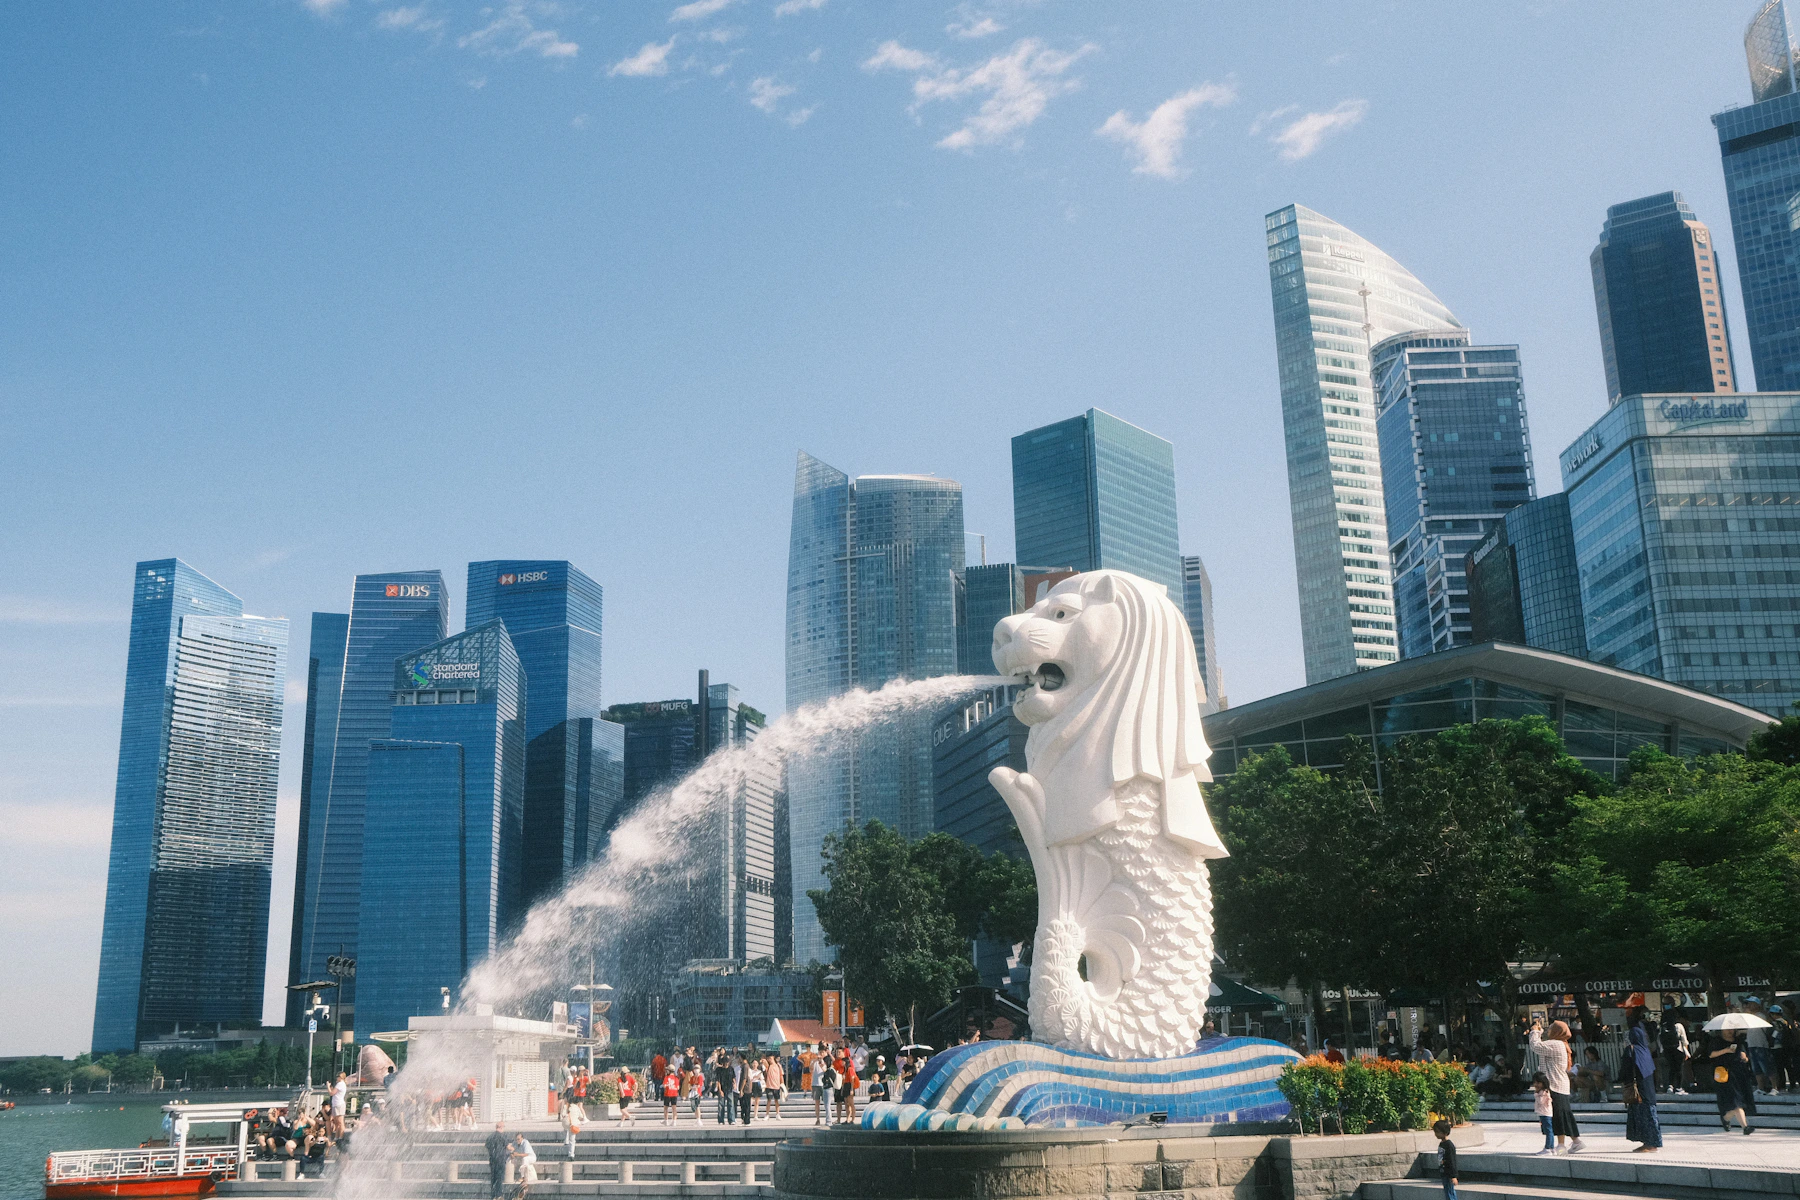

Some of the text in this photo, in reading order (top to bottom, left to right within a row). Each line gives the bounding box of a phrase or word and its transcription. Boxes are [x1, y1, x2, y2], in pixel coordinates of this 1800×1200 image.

[1333, 245, 1364, 261] Keppel
[1660, 396, 1748, 422] CapitaLand
[1566, 433, 1599, 473] wework
[517, 571, 548, 583] HSBC
[400, 584, 430, 597] DBS
[433, 662, 478, 672] standard
[433, 669, 480, 680] chartered
[660, 701, 689, 712] MUFG
[933, 721, 951, 747] OUE
[1585, 980, 1633, 992] COFFEE
[1652, 978, 1703, 990] GELATO
